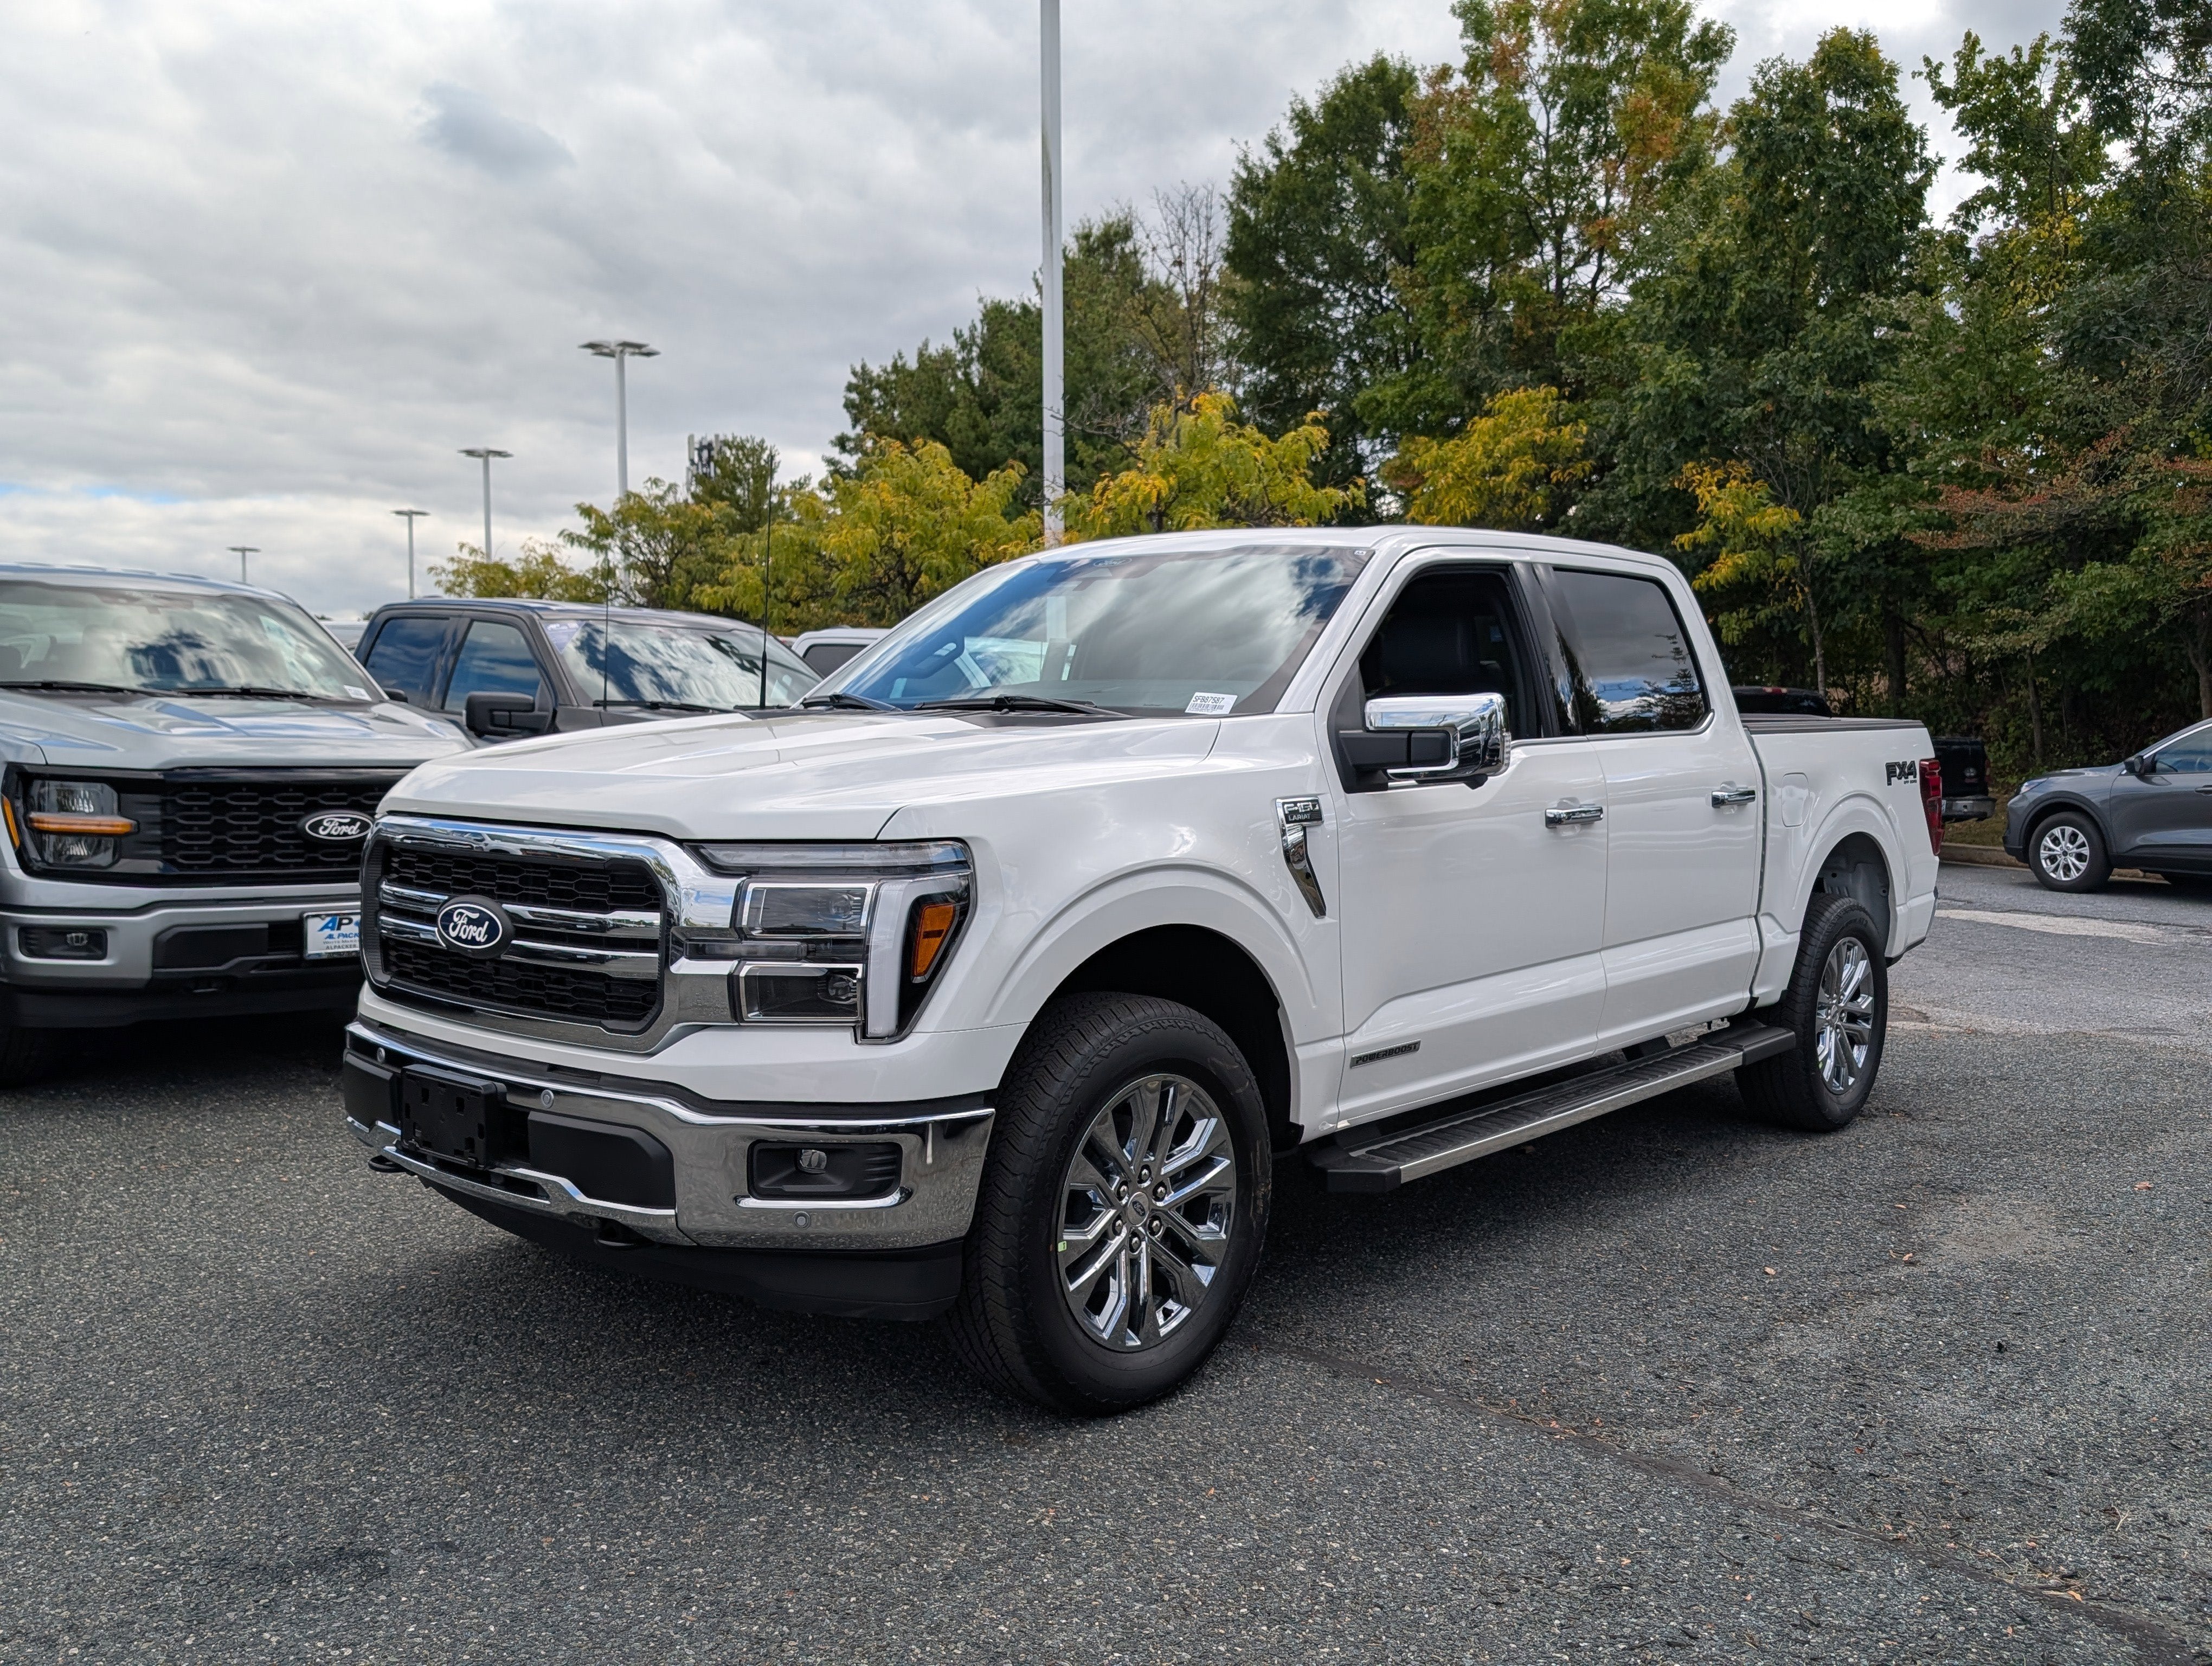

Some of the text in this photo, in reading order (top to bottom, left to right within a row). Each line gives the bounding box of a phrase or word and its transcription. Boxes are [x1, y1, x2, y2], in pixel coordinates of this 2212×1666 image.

[1885, 760, 1917, 786] FX4
[319, 817, 361, 836] Ford
[449, 908, 489, 943] Ford
[1355, 1042, 1418, 1064] POWERBOOST
